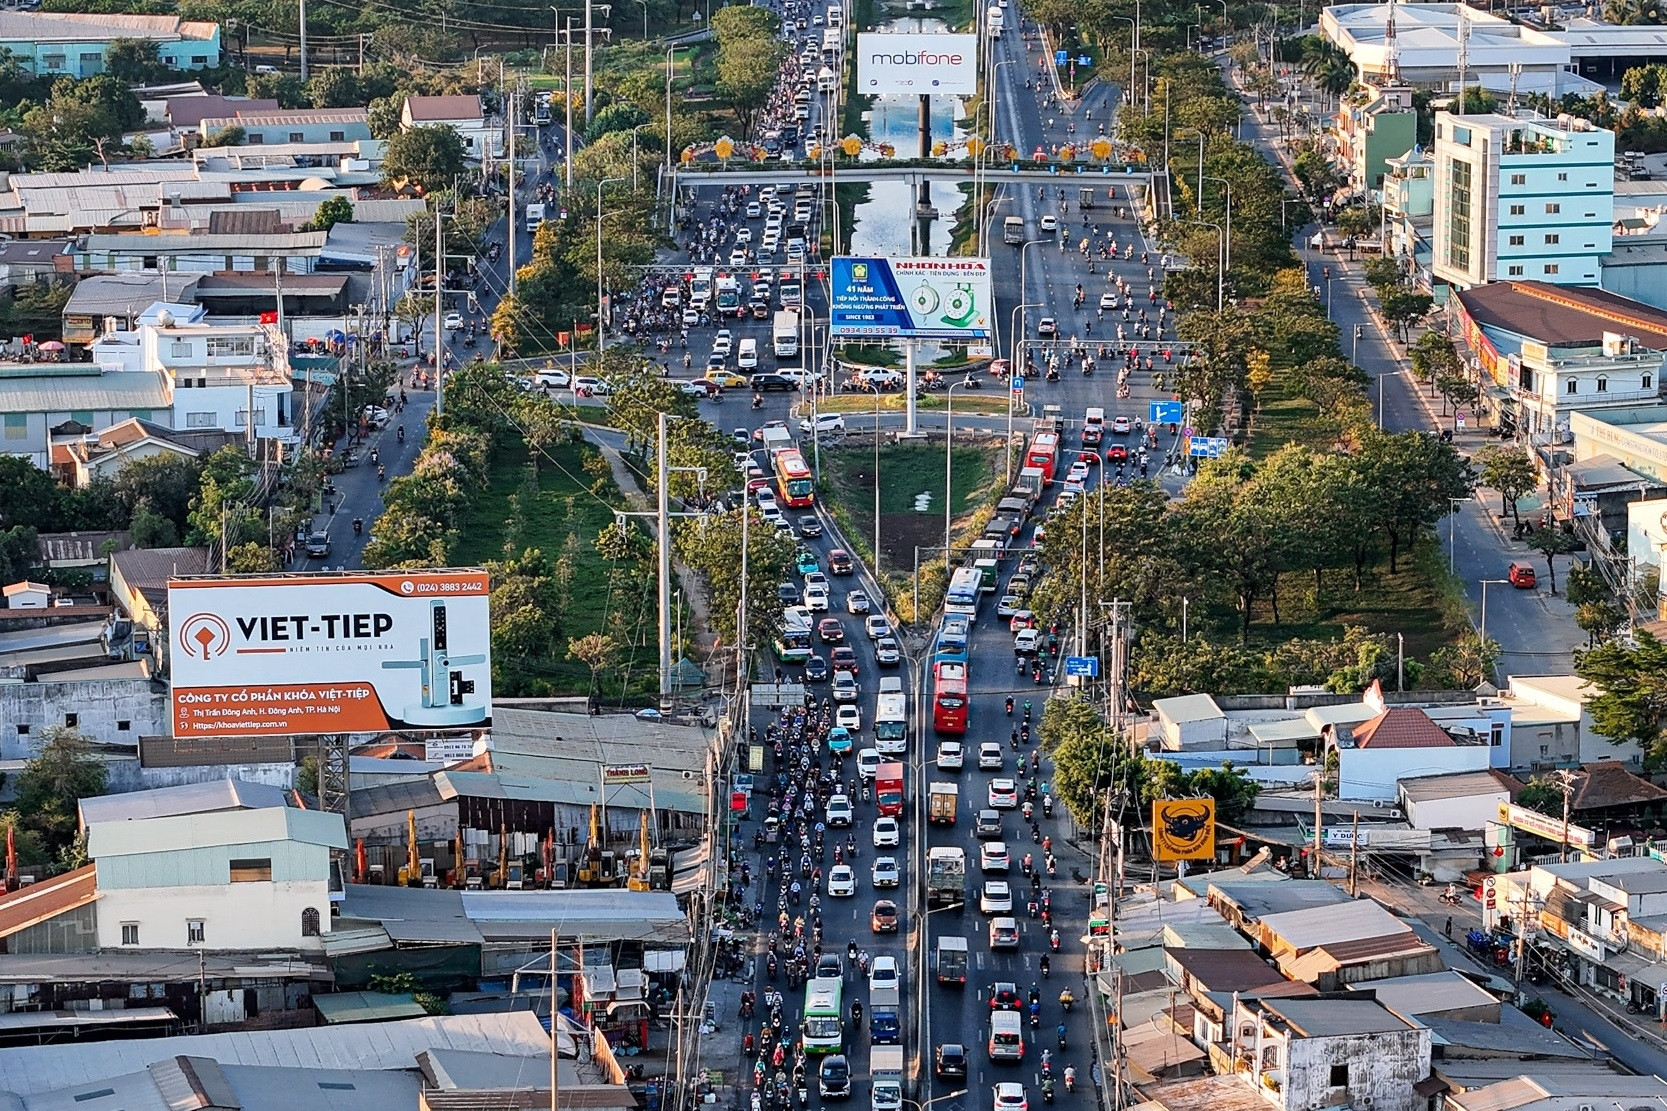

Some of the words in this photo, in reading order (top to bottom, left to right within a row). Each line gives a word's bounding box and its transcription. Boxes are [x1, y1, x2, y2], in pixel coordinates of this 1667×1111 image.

[872, 50, 962, 65] mobifone
[857, 284, 873, 293] NĂM
[417, 583, 438, 592] (024)
[440, 583, 460, 591] 3883
[462, 582, 482, 591] 2442
[236, 614, 393, 641] VIET-TIEP
[178, 692, 212, 704] CÔNG
[214, 693, 229, 702] TY
[231, 688, 248, 702] CỔ
[250, 688, 282, 701] PHẦN
[284, 689, 316, 700] KHÓA
[318, 687, 370, 702] VIỆT-TIỆP
[193, 709, 204, 718] Thị
[205, 708, 220, 716] Trấn
[222, 708, 240, 717] Đông
[242, 708, 258, 716] Anh,
[268, 707, 286, 716] Đông
[328, 706, 341, 714] Nội
